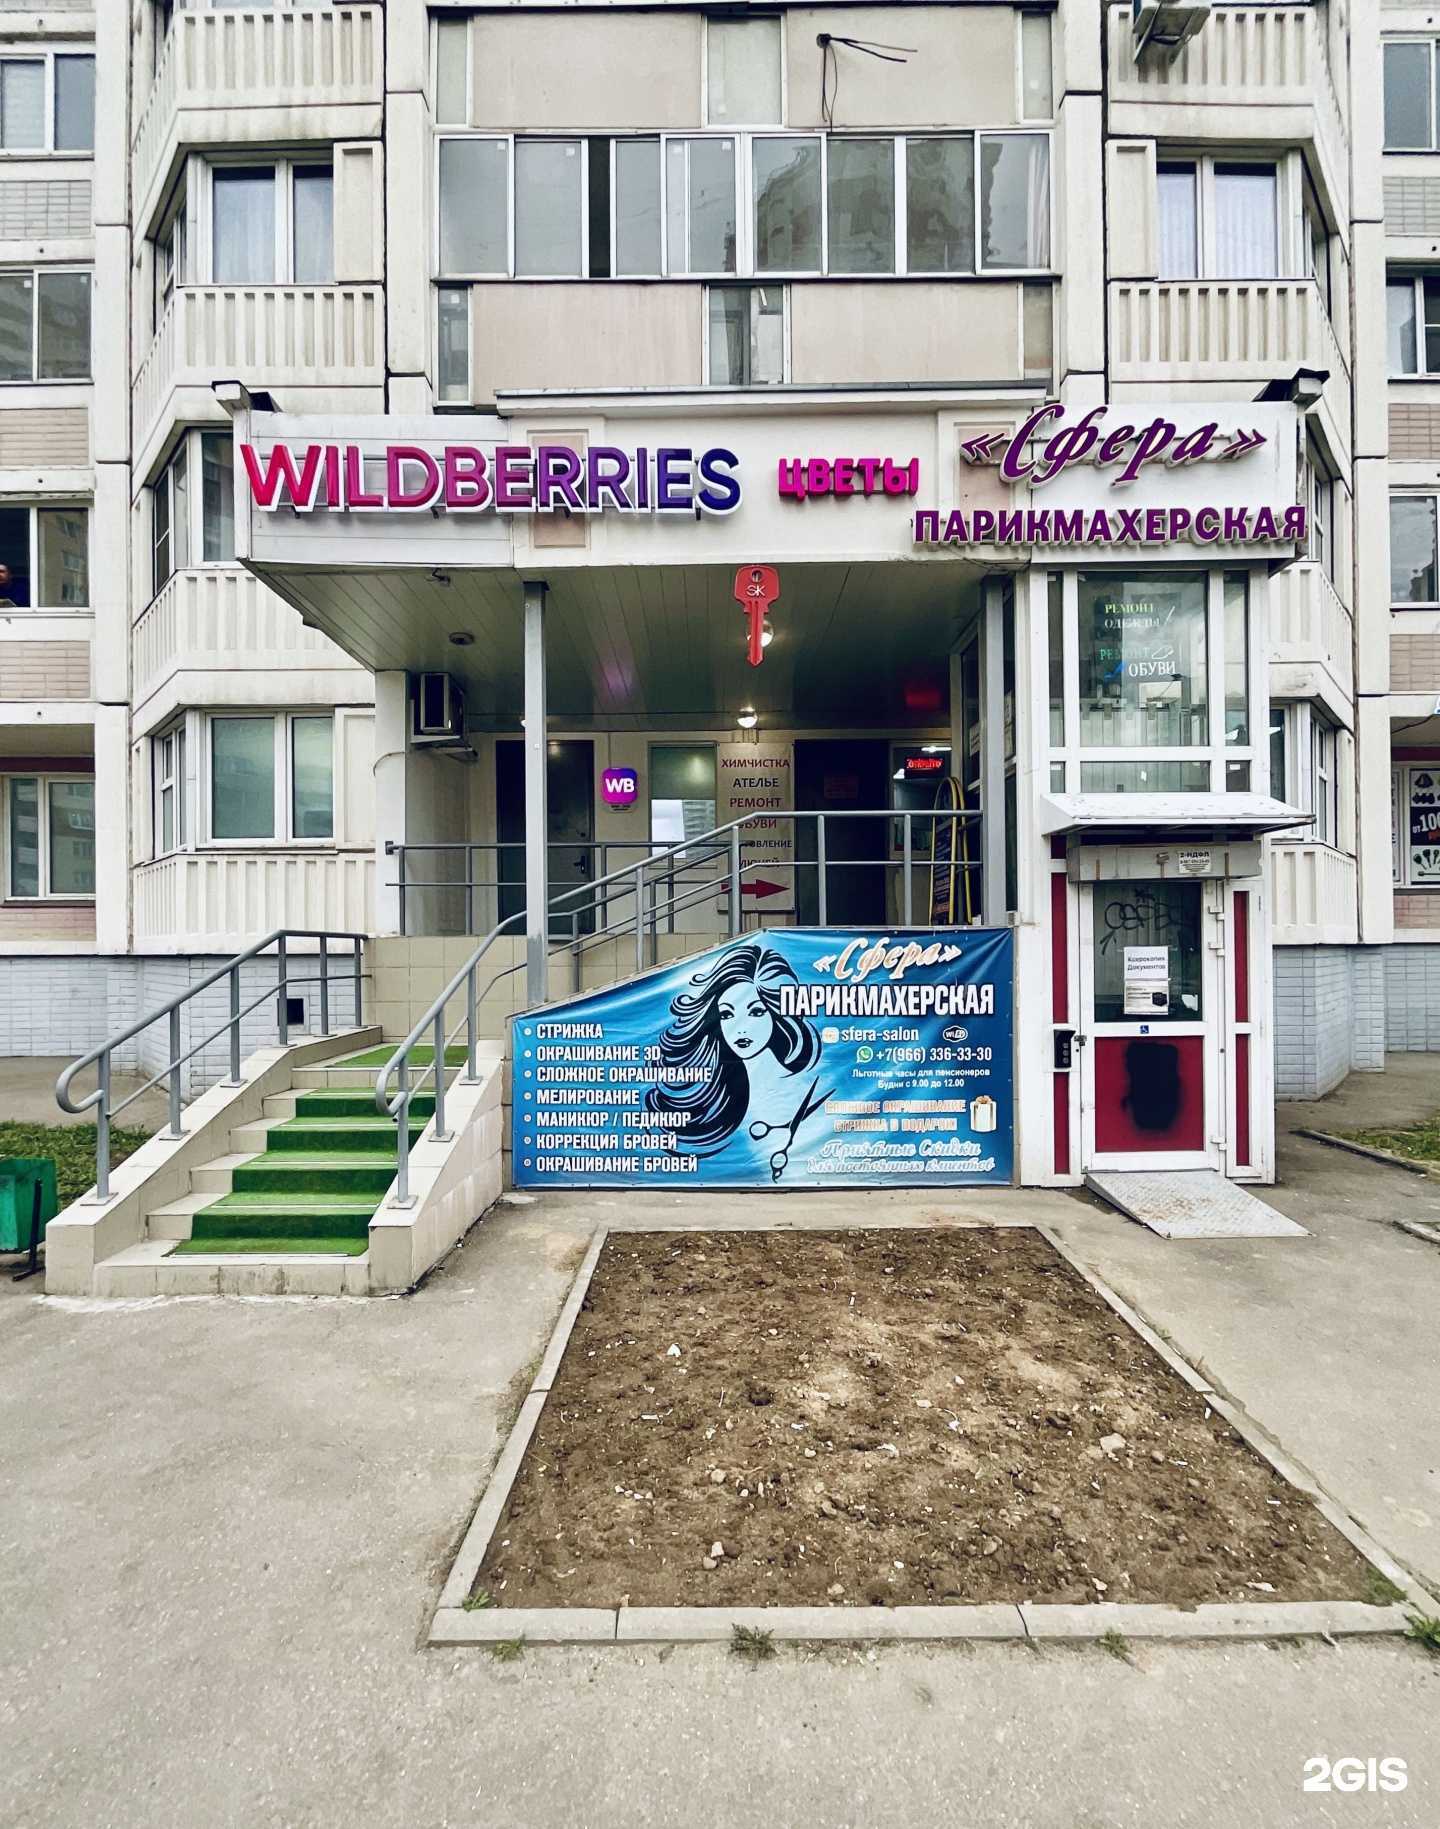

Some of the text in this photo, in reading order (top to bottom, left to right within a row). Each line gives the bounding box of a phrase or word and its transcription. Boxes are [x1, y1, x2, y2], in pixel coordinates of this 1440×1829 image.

[240, 444, 741, 515] WILDBERRIES
[778, 457, 920, 500] ЦВЕТЫ
[914, 505, 1306, 545] ПАРИКМАХЕРСКАЯ
[1128, 661, 1176, 678] ОБУВИ
[721, 758, 790, 769] ХИМЧИСТКА
[605, 777, 635, 793] WB
[732, 777, 779, 788] АТЕЛЬЕ
[729, 798, 781, 808] РЕМОНТ
[780, 983, 994, 1017] ПАРИКМАХЕРСКАЯ
[536, 1023, 603, 1039] СТРИЖКА
[841, 1026, 919, 1042] sfera-salon
[536, 1045, 662, 1061] ОКРАШИВАНИЕ 3D
[875, 1046, 993, 1063] +7(966) 336-33-30
[536, 1067, 713, 1083] СЛОЖНОЕ ОКРАШИВАНИЕ
[917, 1070, 933, 1078] для
[935, 1068, 991, 1076] пенсионеров
[878, 1080, 904, 1090] Будни
[912, 1079, 929, 1088] 9.00
[943, 1079, 965, 1088] 12.00
[536, 1089, 640, 1105] МЕЛИРОВАНИЕ
[536, 1112, 609, 1127] МАНИКЮР
[622, 1112, 692, 1129] ПЕДИКЮР
[536, 1131, 678, 1151] КОРРЕКЦИЯ БРОВЕЙ
[536, 1153, 698, 1173] ОКРАШИВАНИЕ БРОВЕЙ
